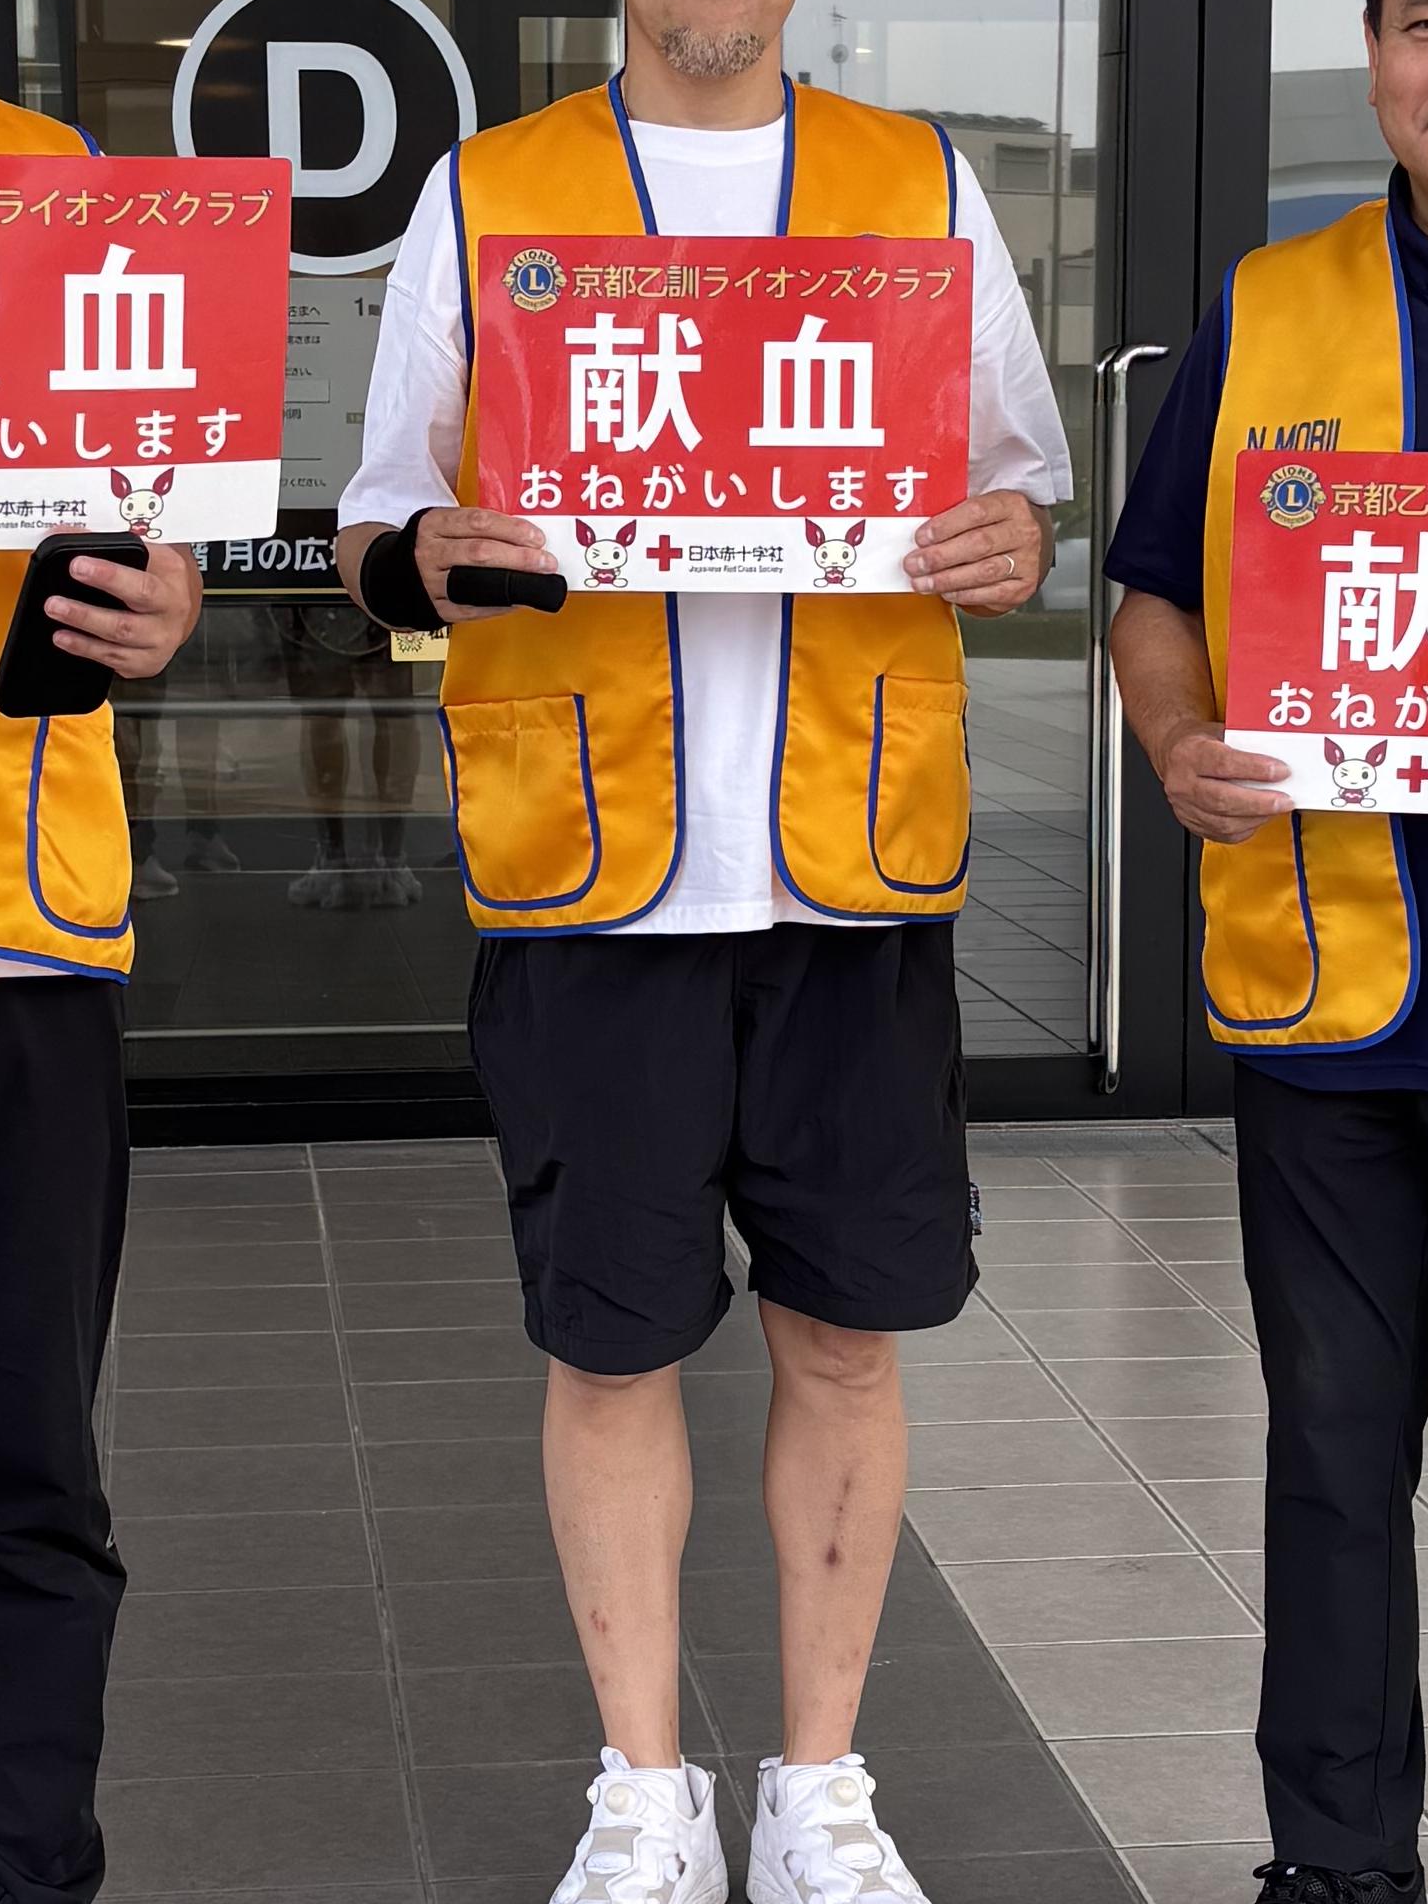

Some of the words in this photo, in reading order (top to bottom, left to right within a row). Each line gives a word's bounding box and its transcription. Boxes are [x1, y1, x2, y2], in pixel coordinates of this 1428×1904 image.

[266, 41, 397, 198] D
[528, 267, 545, 291] L
[570, 262, 957, 302] 京都乙訓ライオンズクラブ
[565, 312, 886, 455] 献血
[519, 463, 929, 513] おねがいします
[1286, 484, 1303, 507] L
[689, 545, 784, 563] 日本赤十字社
